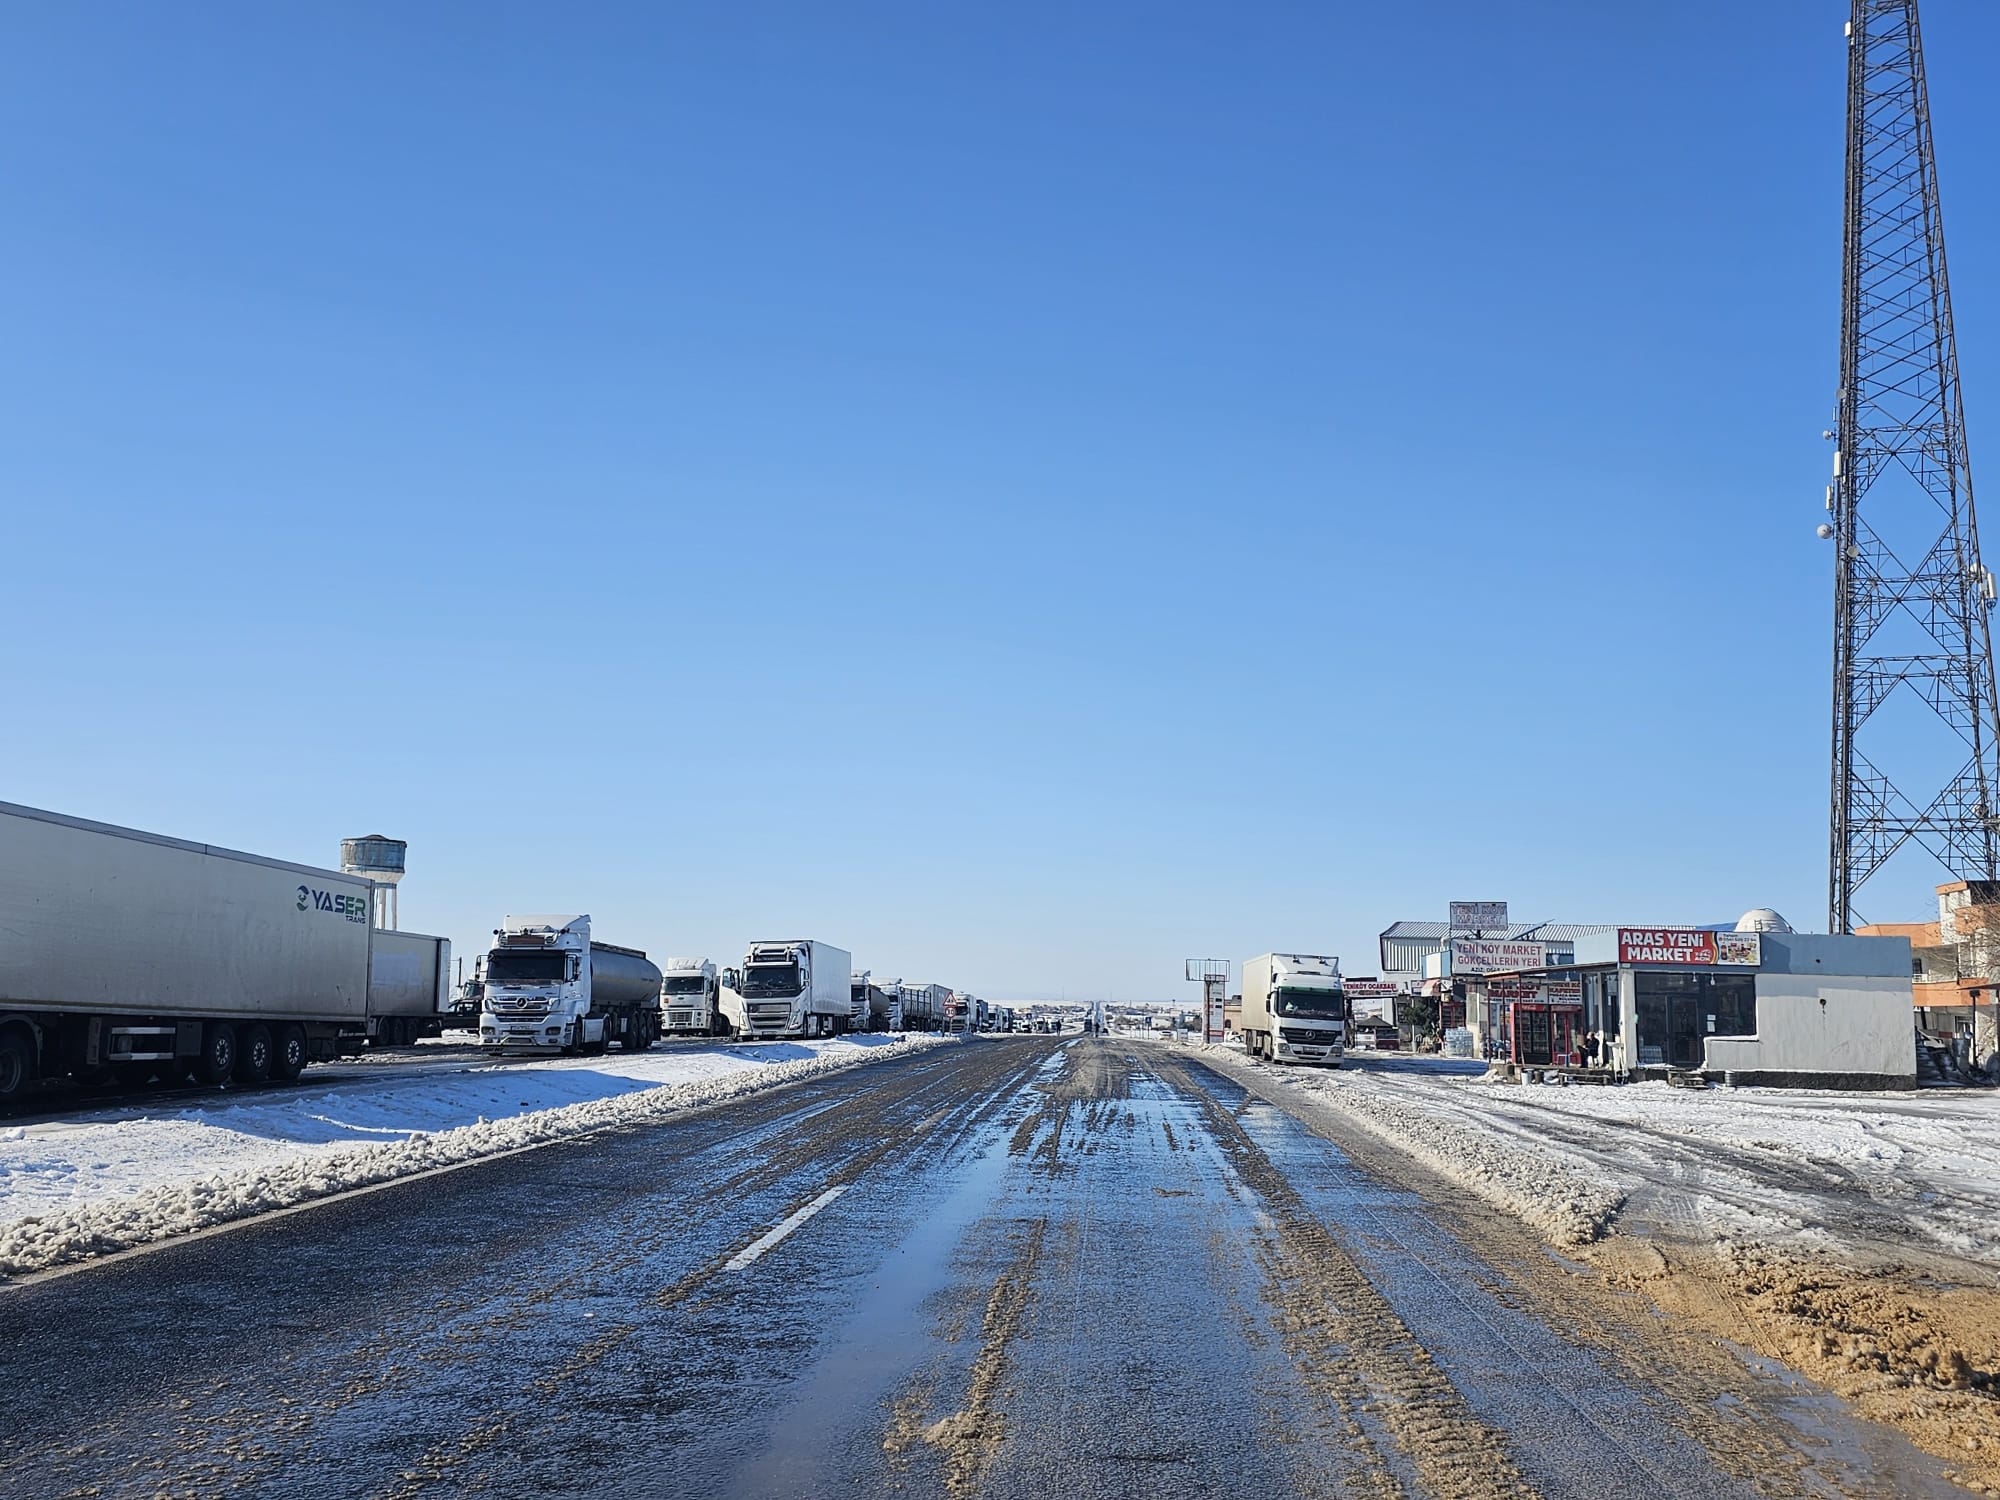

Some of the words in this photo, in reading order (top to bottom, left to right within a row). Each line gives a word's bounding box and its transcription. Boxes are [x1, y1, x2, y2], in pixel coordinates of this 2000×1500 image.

[312, 889, 366, 917] YASER
[1455, 914, 1502, 924] MARKET
[1621, 931, 1665, 946] ARAS
[1503, 944, 1542, 956] MARKET
[1627, 947, 1693, 962] MARKET
